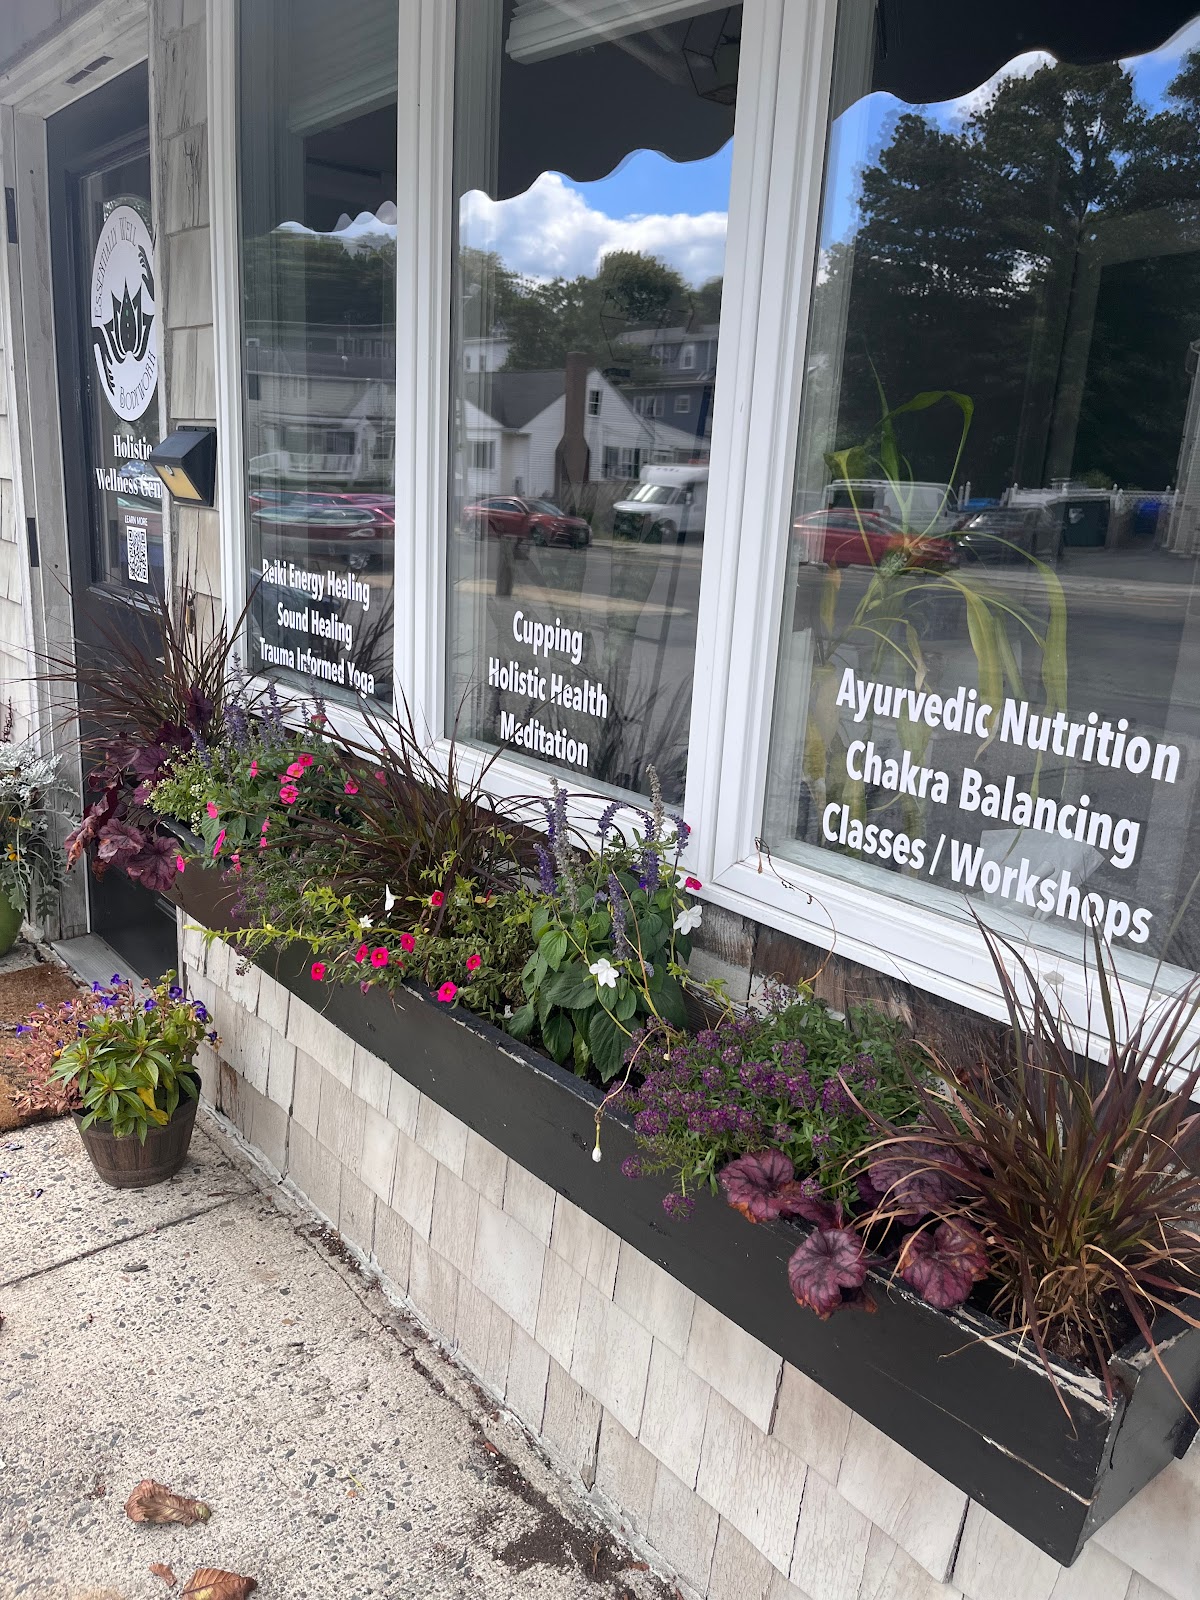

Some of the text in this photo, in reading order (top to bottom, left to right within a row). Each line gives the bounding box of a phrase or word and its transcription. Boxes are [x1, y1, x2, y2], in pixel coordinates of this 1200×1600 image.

[95, 467, 162, 499] Wellness Cen
[124, 514, 148, 527] LEARN MORE
[262, 558, 370, 612] Reiki Energy Healing
[277, 601, 353, 651] Sound Healing
[512, 610, 583, 666] Cupping
[259, 637, 375, 699] Trauma Informed Yoga
[488, 656, 608, 719] Holistic Health
[500, 710, 589, 768] Meditation
[835, 667, 1181, 784] Ayurvedic Nutrition
[845, 740, 1141, 870] Chakra Balancing
[822, 802, 1154, 946] Classes / Workshops
